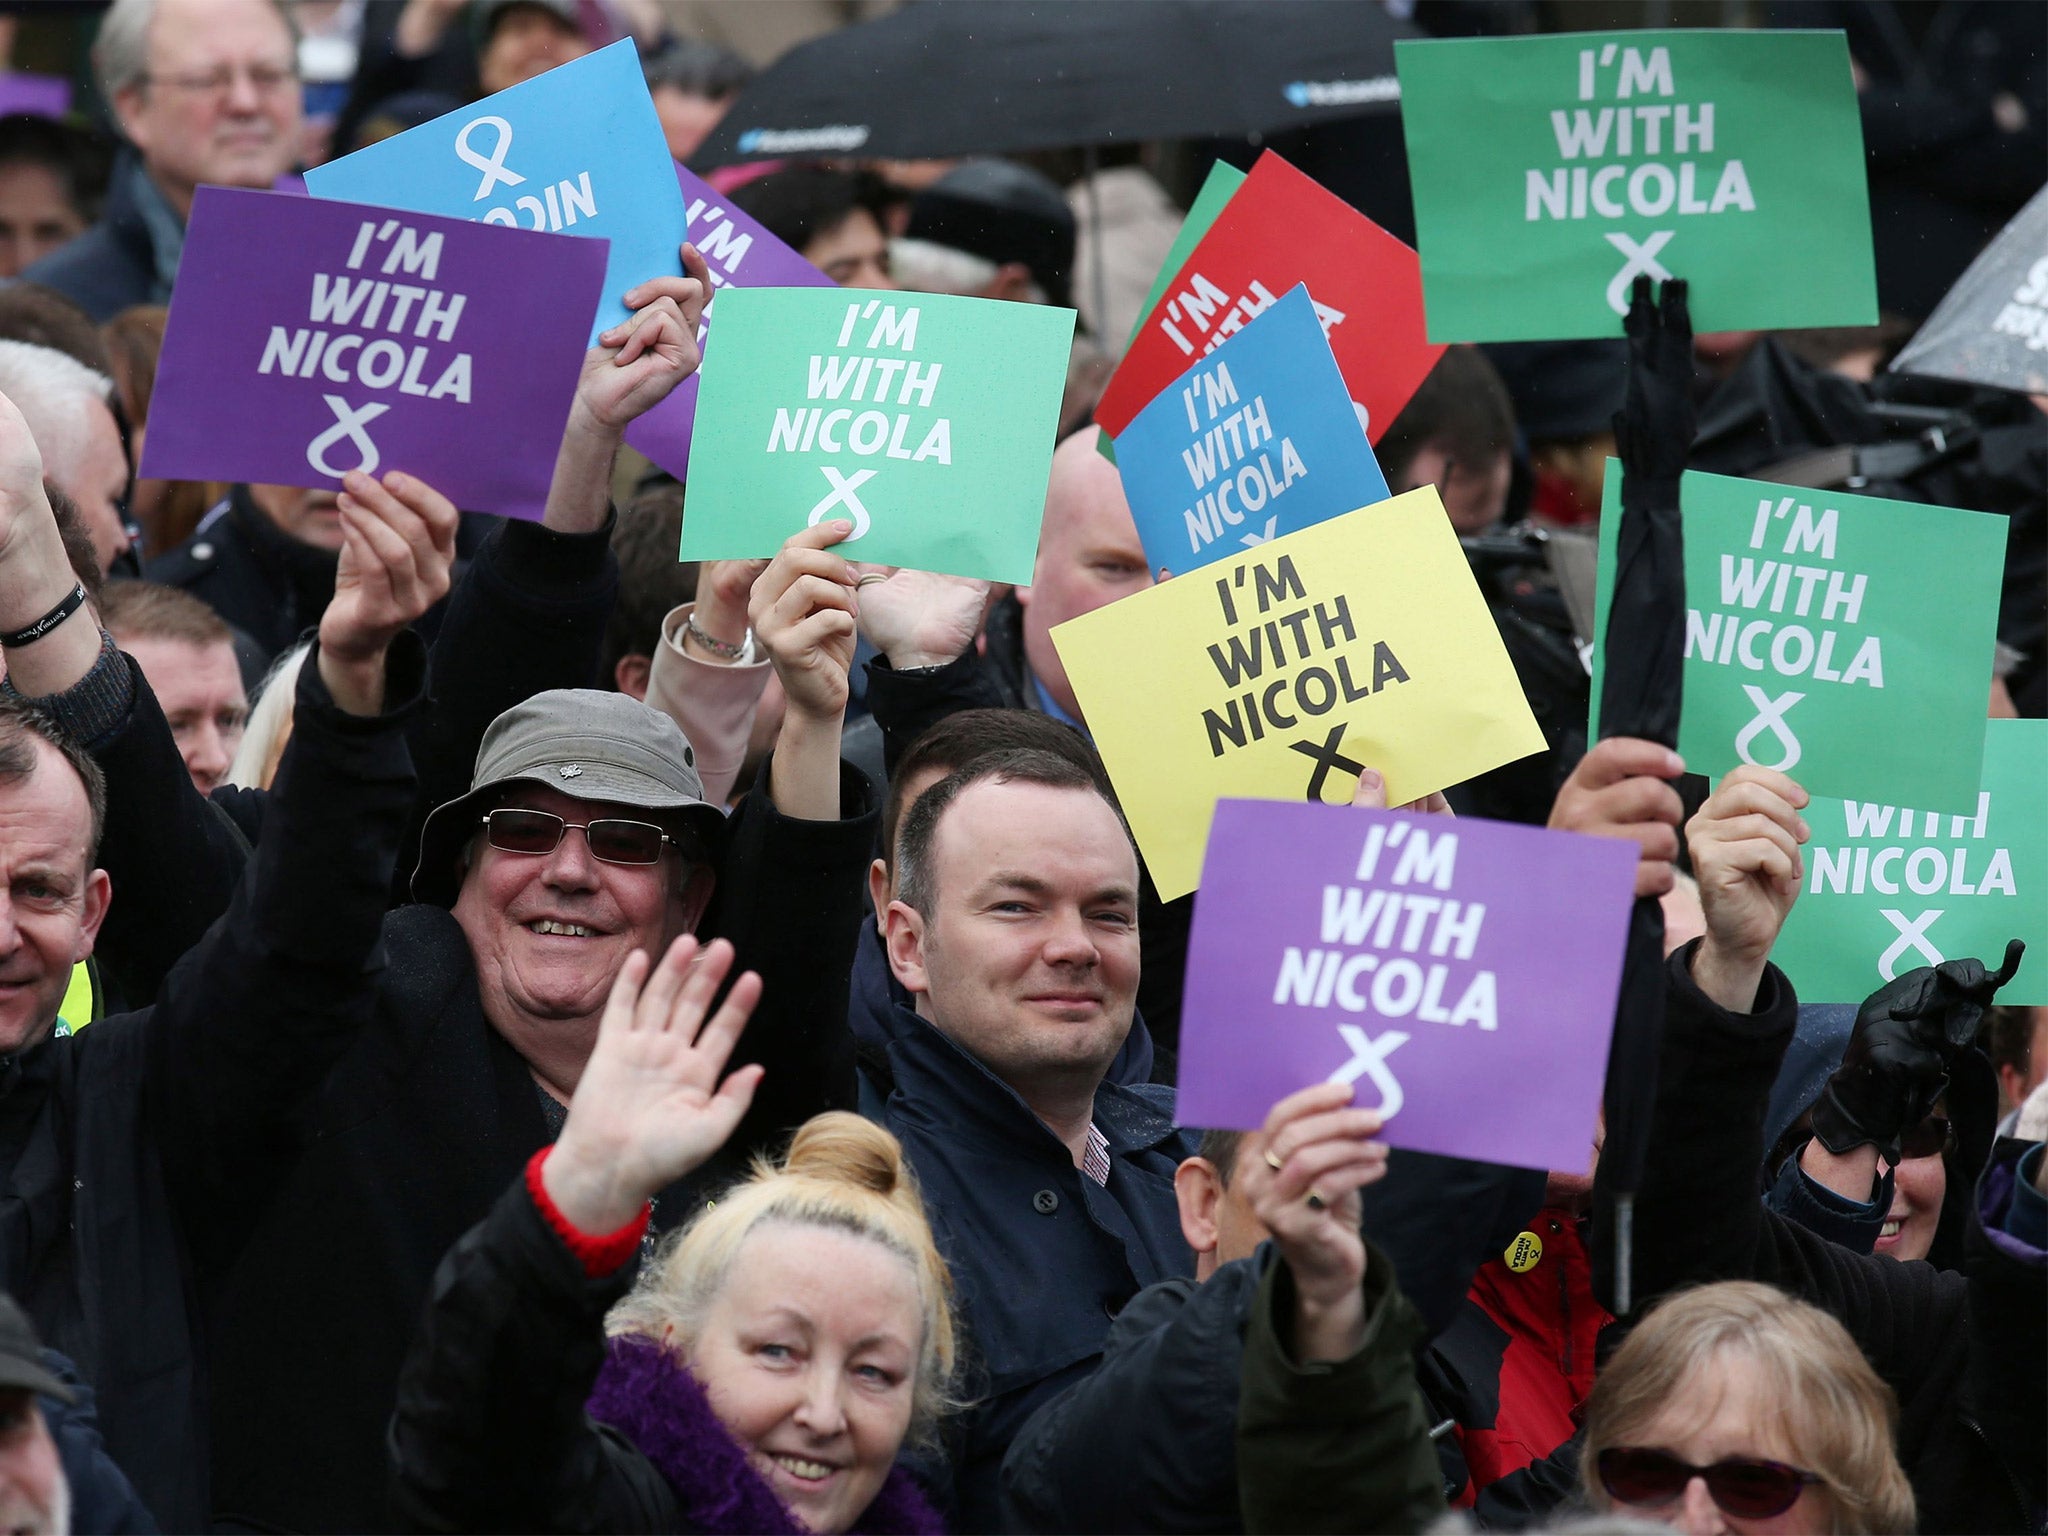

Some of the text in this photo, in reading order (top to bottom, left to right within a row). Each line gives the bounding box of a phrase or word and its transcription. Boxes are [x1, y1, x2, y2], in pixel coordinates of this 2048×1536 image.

[1579, 43, 1675, 101] I'M
[1551, 102, 1714, 160] WITH
[469, 171, 598, 232] NIC
[1525, 160, 1756, 221] NICOLA
[346, 219, 444, 281] I'M
[309, 273, 467, 342] WITH
[837, 300, 921, 351] I'M
[1160, 272, 1230, 356] I'M
[257, 325, 472, 404] NICOLA
[807, 355, 943, 407] WITH
[1183, 361, 1240, 433] I'M
[766, 408, 952, 465] NICOLA
[1182, 395, 1273, 491] WITH
[1183, 436, 1308, 555] NICOLA
[1750, 497, 1839, 560] I'M
[1216, 554, 1307, 626] I'M
[1721, 554, 1868, 624] WITH
[1206, 594, 1357, 689] WITH
[1684, 608, 1884, 688] NICOLA
[1201, 640, 1411, 758] NICOLA
[1355, 820, 1459, 892] I'M
[1810, 847, 2017, 896] NICOLA
[1320, 884, 1487, 961] WITH
[1272, 946, 1498, 1032] NICOLA
[1511, 1237, 1526, 1268] NICOLA
